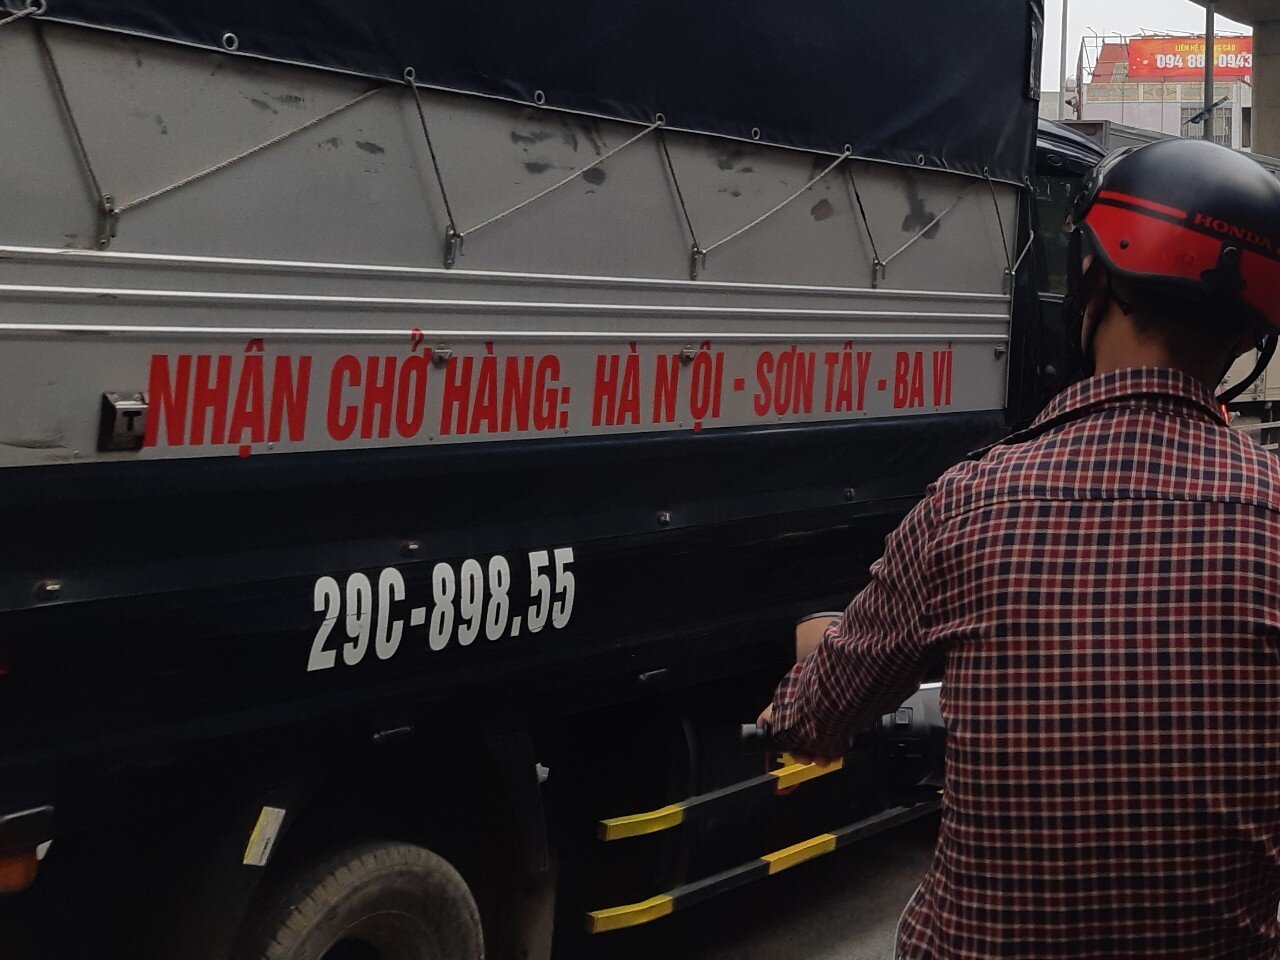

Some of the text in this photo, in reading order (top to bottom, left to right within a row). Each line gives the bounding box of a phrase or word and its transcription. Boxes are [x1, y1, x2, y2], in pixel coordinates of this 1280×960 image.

[1156, 54, 1183, 68] 094
[1218, 54, 1252, 68] 0943
[1193, 213, 1272, 249] HONDA
[142, 338, 312, 458] NHẬN
[326, 328, 432, 441] CHỞ
[439, 341, 570, 435] HÀNG:
[591, 341, 641, 426] HÀ
[753, 345, 816, 417] SƠN
[824, 341, 871, 413] TÂY
[893, 351, 925, 410] BA
[307, 547, 575, 672] 29C-898.55
